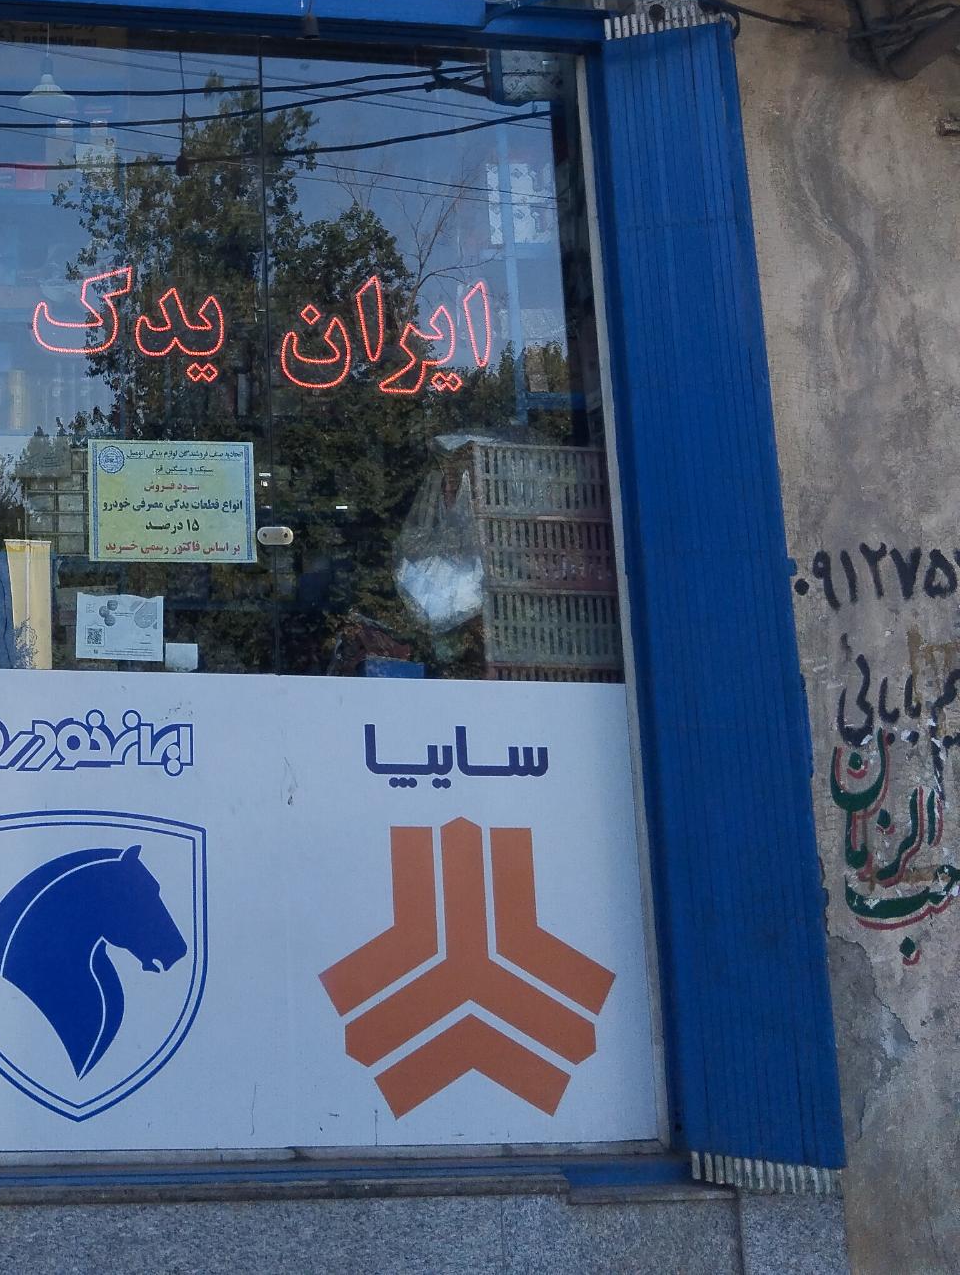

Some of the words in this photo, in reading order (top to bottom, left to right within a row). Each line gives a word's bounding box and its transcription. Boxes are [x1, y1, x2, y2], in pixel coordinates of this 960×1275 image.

[31, 266, 225, 383] یدک
[280, 274, 492, 394] ایران
[163, 450, 178, 460] لوازم
[165, 465, 188, 474] سنگین
[144, 480, 176, 493] فروش
[177, 482, 200, 493] سود
[102, 497, 131, 512] خودرو
[132, 498, 164, 512] مصرفی
[165, 499, 189, 512] یدکی
[191, 498, 220, 510] قطعات
[221, 499, 243, 513] انواع
[145, 520, 183, 534] درصد
[187, 518, 200, 532] ۱۵
[105, 541, 138, 554] خرید
[140, 544, 170, 555] رسمی
[173, 540, 200, 555] فاکتور
[203, 542, 229, 555] اساس
[232, 545, 241, 555] بر
[794, 541, 960, 611] ۰۹۱۲۷۵
[363, 723, 549, 790] سایپا
